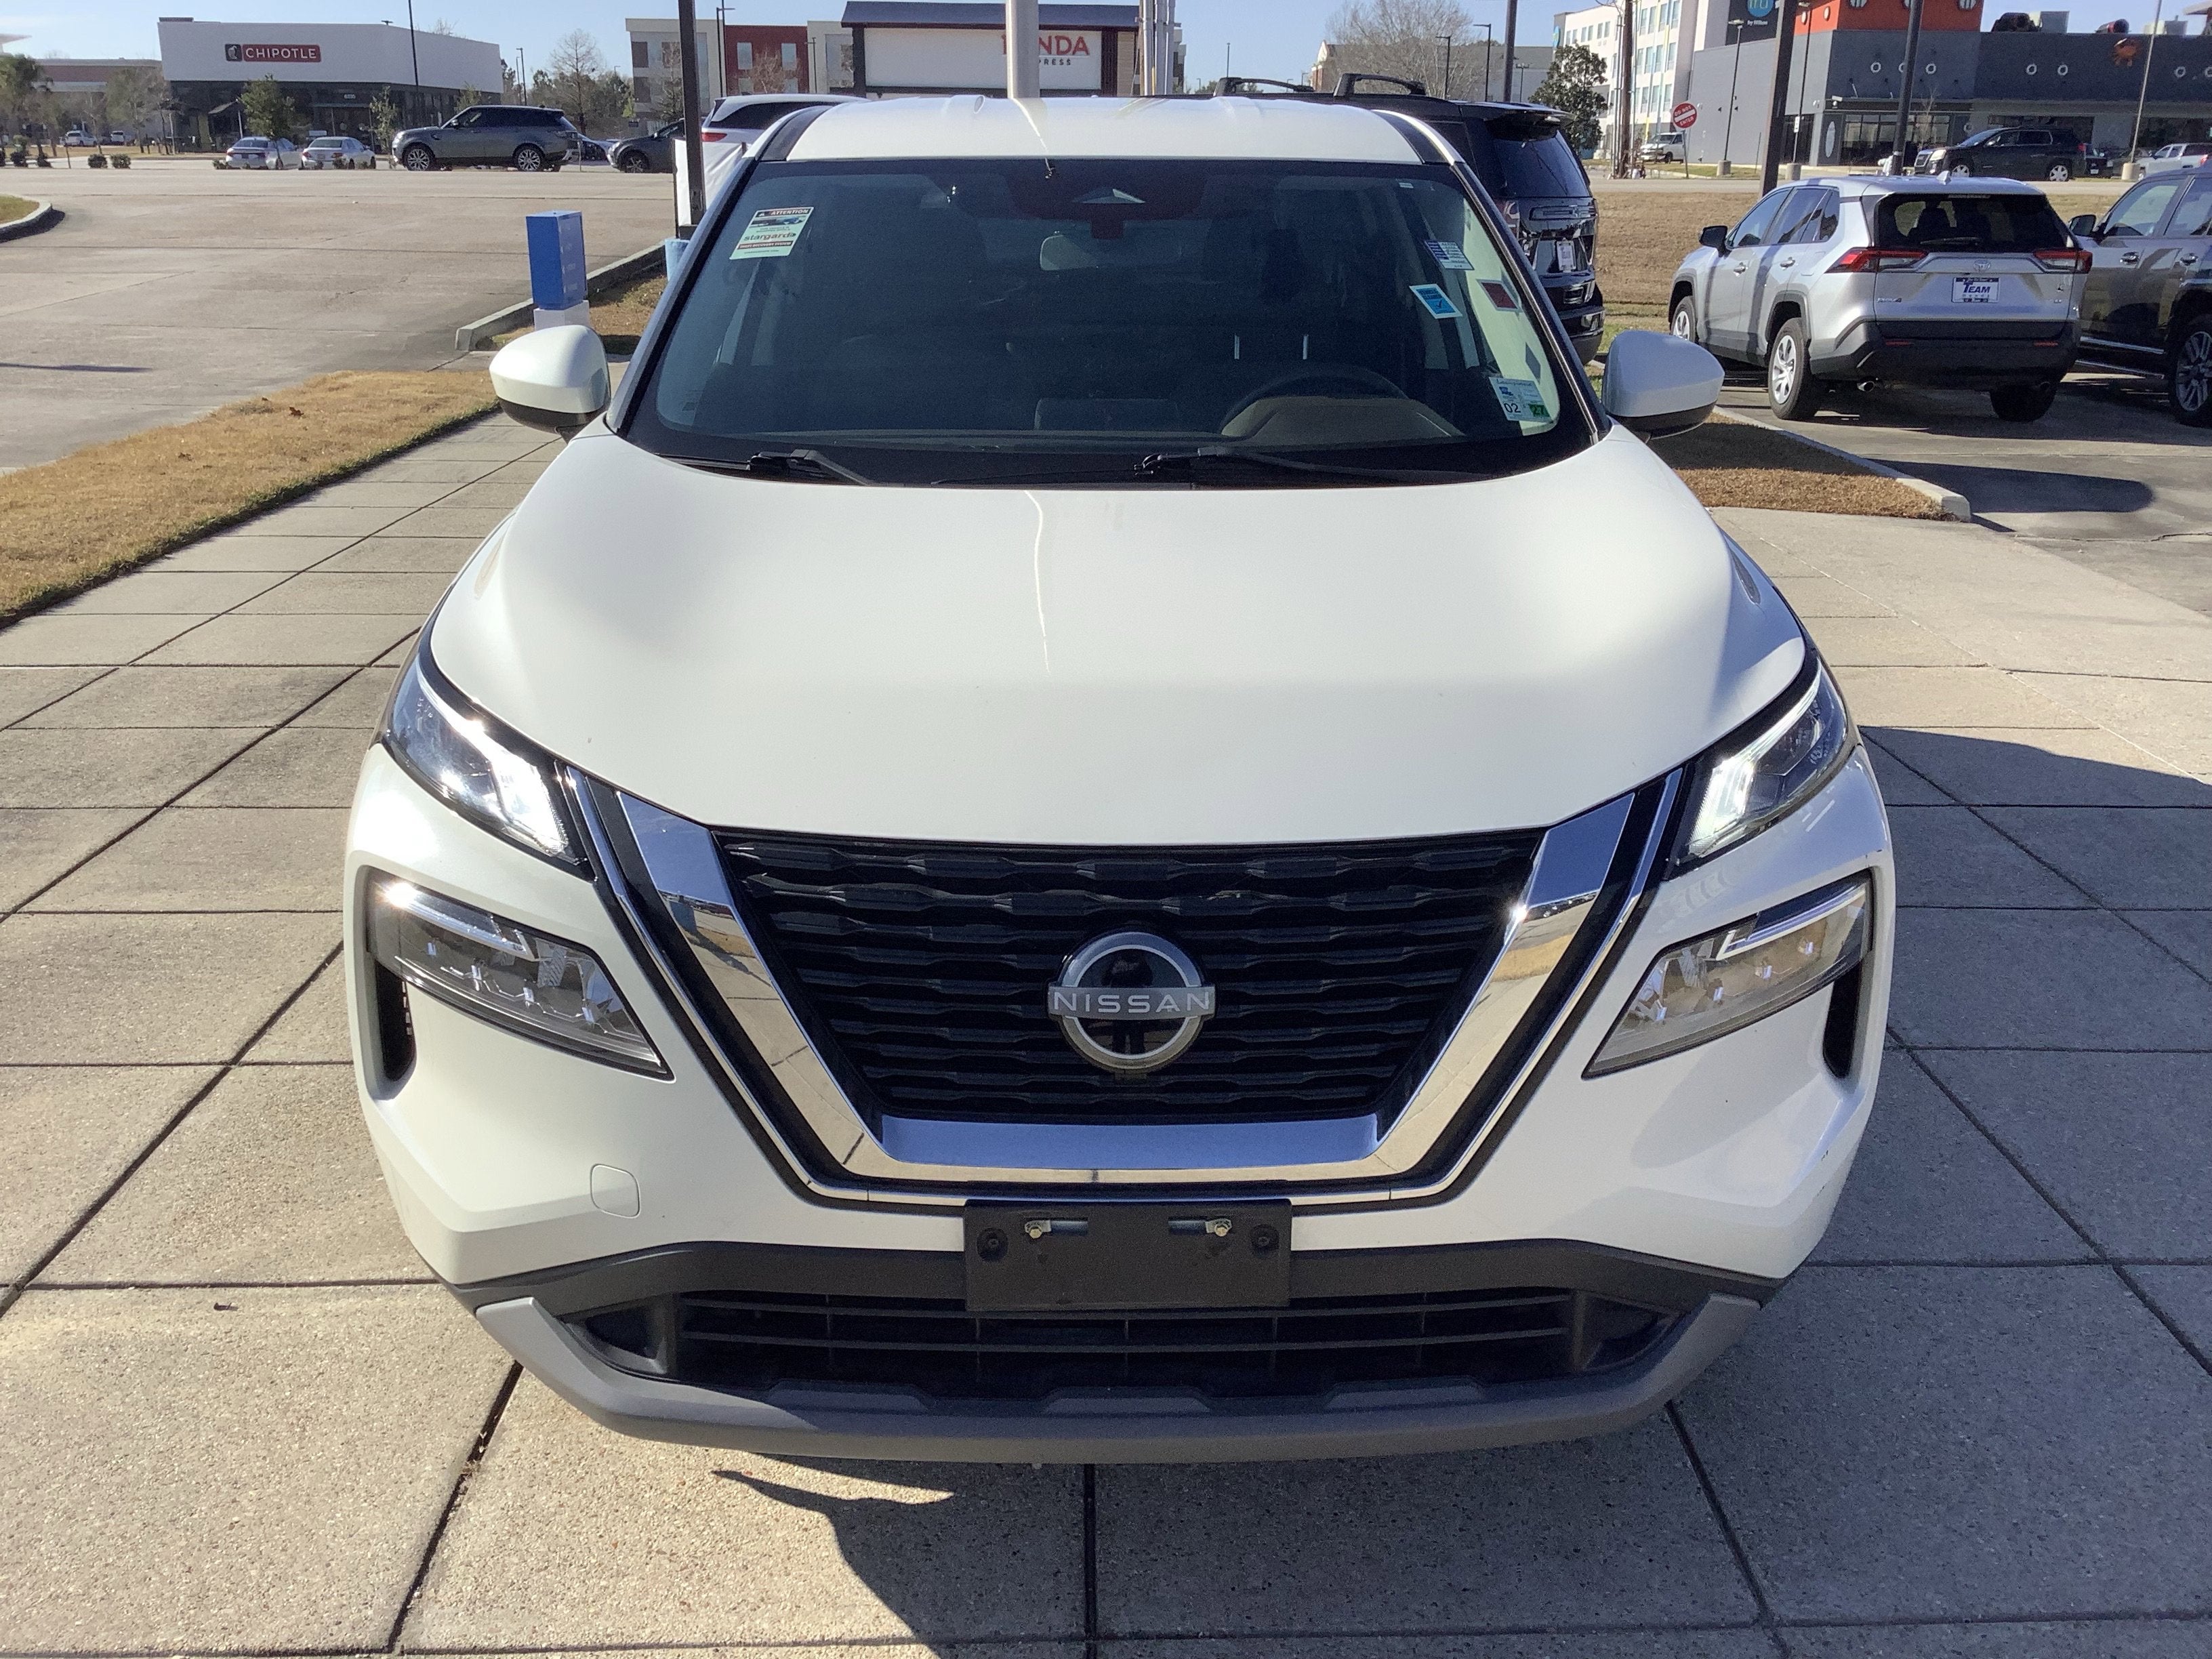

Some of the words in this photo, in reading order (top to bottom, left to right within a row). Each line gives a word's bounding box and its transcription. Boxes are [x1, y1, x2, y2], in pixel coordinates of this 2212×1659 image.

[245, 47, 316, 59] CHIPOTLE
[1680, 116, 1694, 126] ENTER
[1963, 281, 1990, 293] TEAM
[1503, 403, 1521, 413] 02
[1054, 991, 1209, 1013] NISSAN
